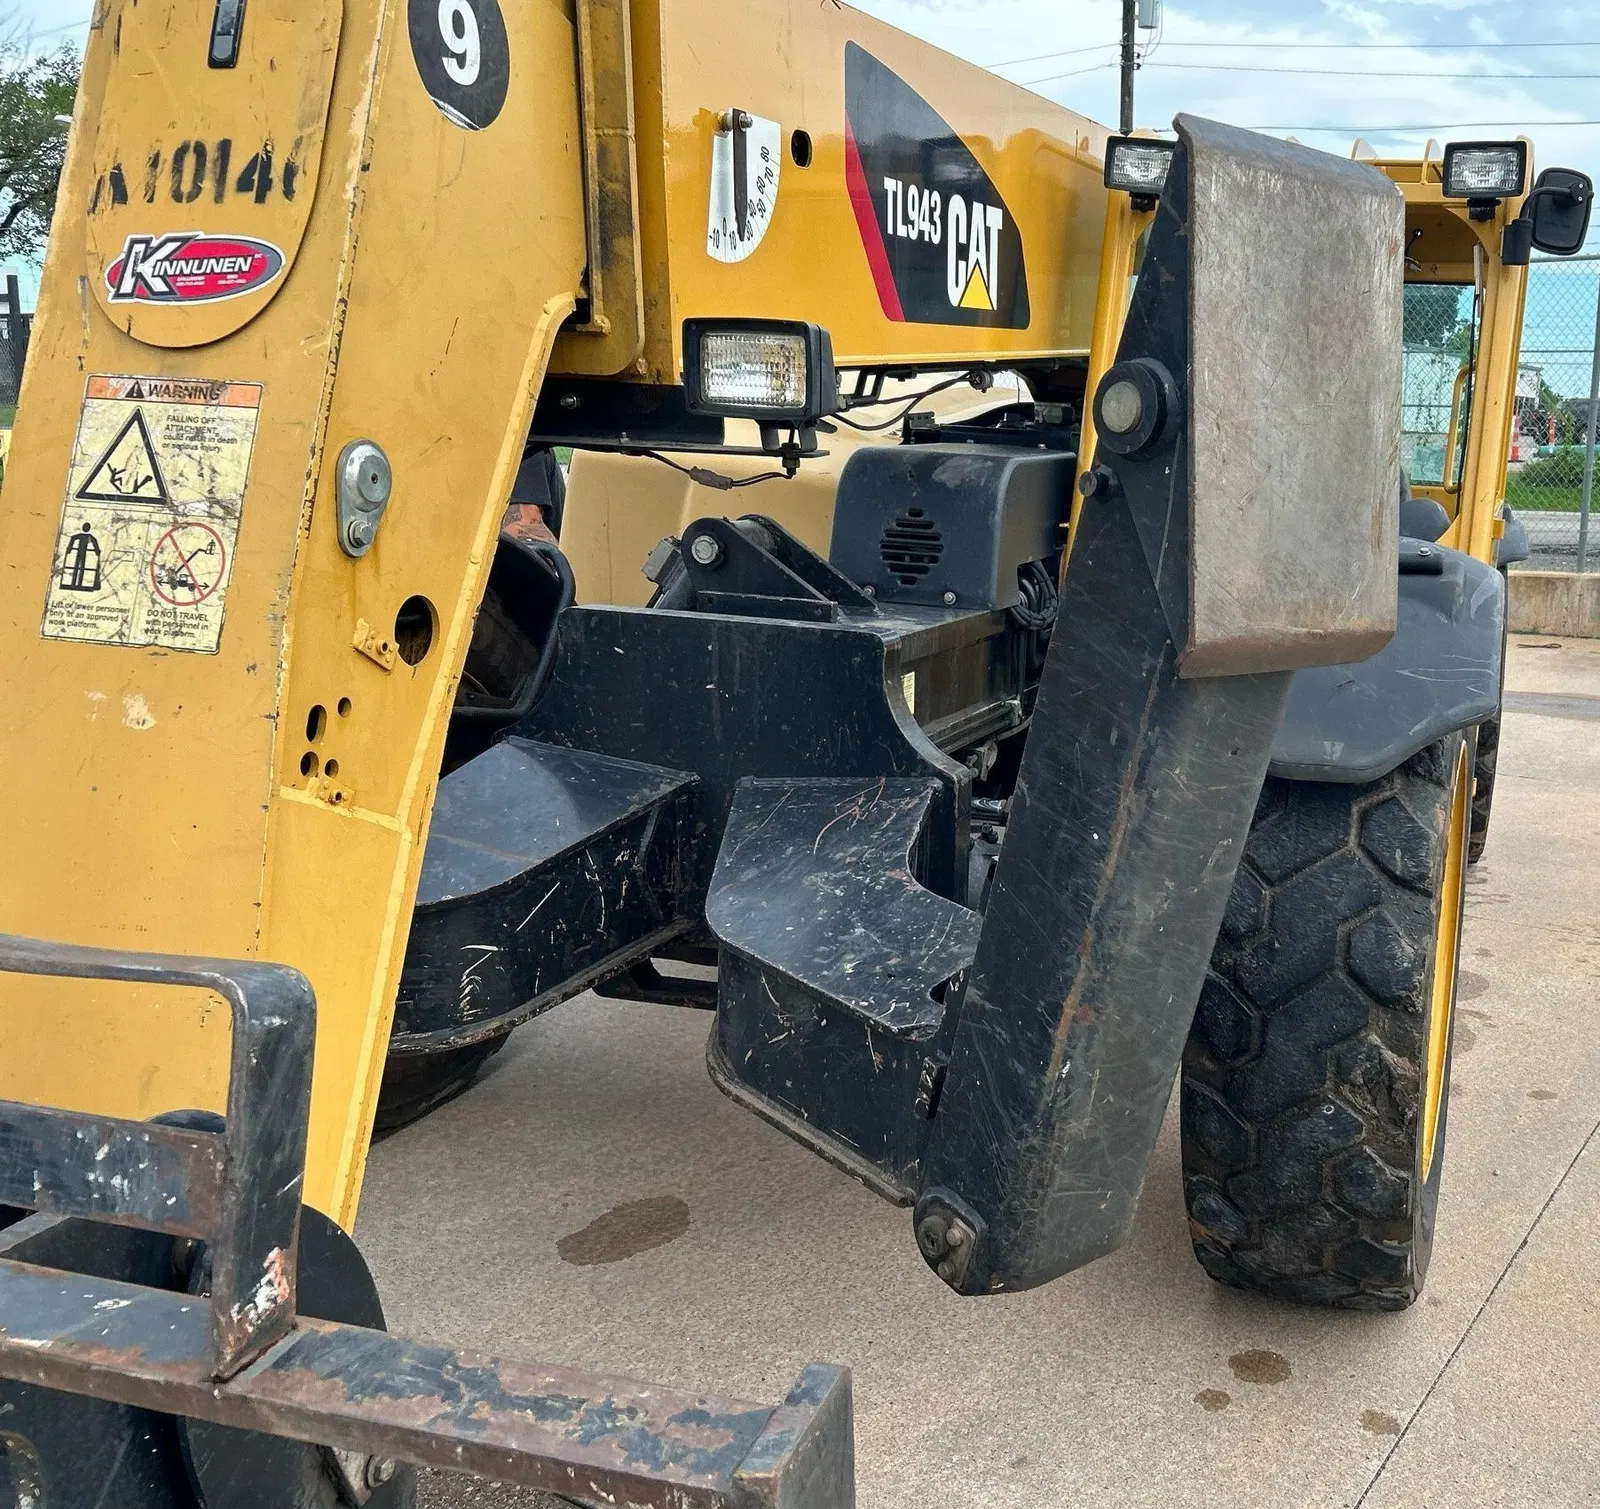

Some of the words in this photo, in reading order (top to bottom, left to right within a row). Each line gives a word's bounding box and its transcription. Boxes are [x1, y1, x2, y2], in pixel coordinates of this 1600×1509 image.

[438, 0, 480, 86] 9
[761, 146, 770, 163] 80
[764, 167, 774, 185] 70
[756, 176, 766, 195] 60
[757, 198, 767, 218] 50
[722, 217, 727, 237] 0
[729, 230, 737, 250] 10
[884, 176, 942, 245] TL943
[947, 194, 1003, 311] CAT
[112, 235, 252, 300] KINNUNEN
[148, 383, 221, 401] WARNING
[166, 415, 199, 424] FALLING
[201, 416, 217, 424] OFF
[217, 436, 238, 444] death
[86, 613, 119, 622] approved
[147, 609, 159, 617] DO
[160, 610, 177, 619] NOT
[179, 611, 209, 621] TRAVEL
